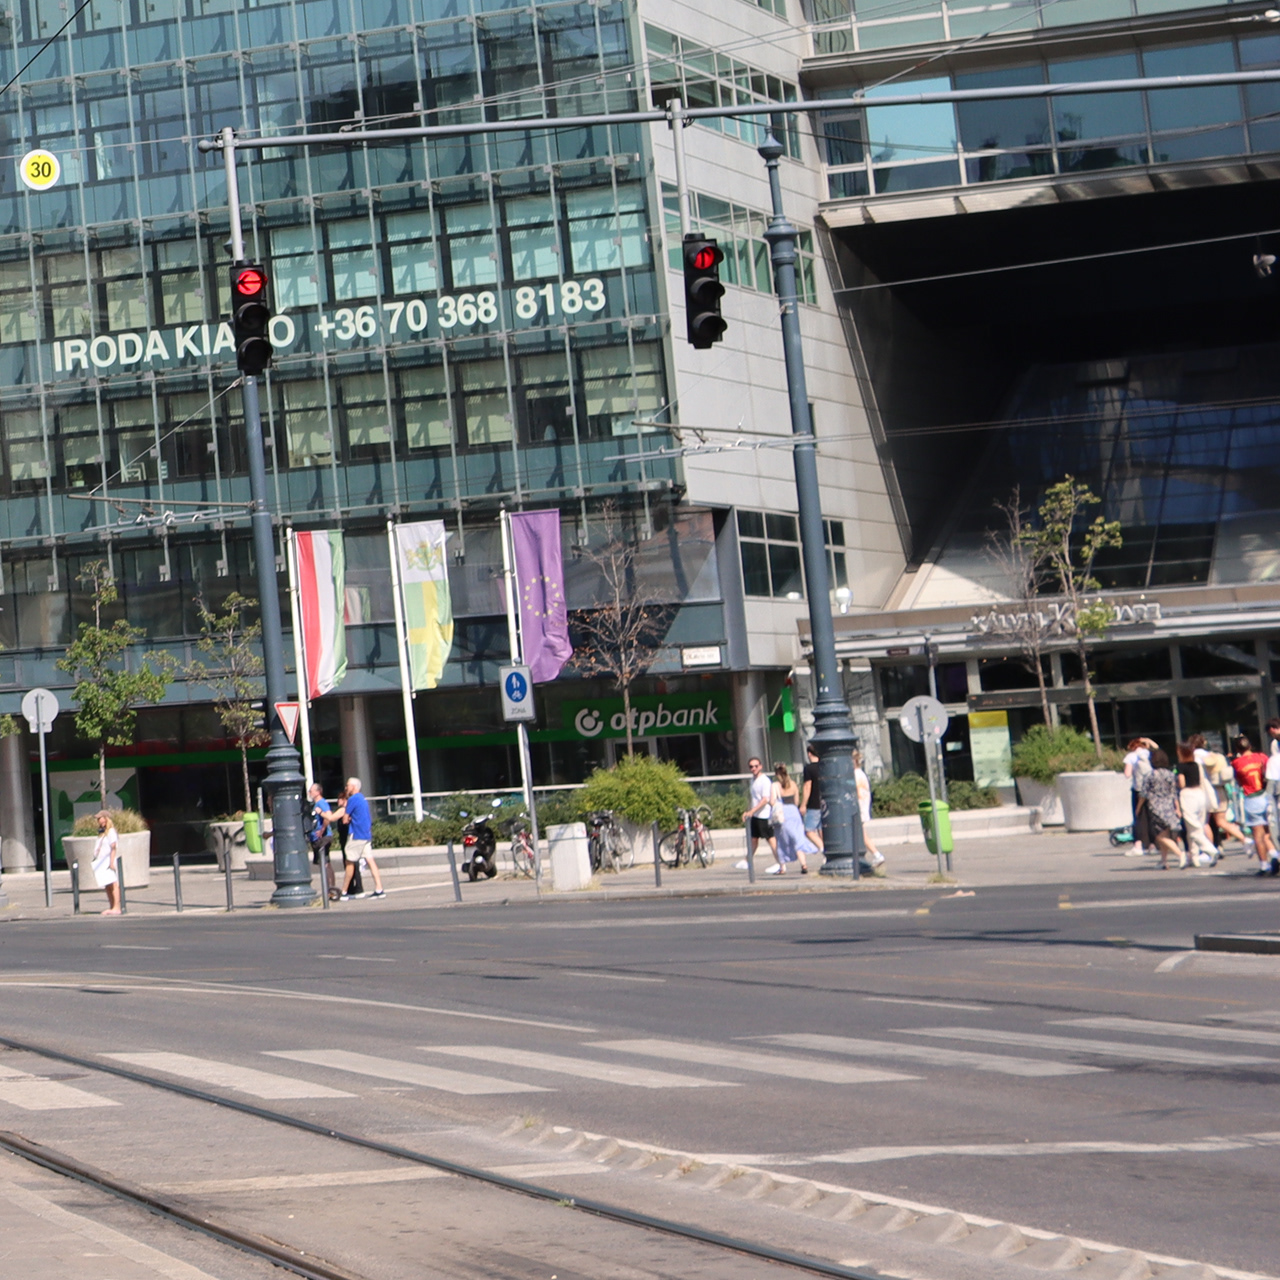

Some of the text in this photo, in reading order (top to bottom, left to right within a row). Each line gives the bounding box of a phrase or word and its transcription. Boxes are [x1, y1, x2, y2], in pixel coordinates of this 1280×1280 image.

[31, 161, 52, 178] 30
[53, 278, 606, 372] IRODA KIAÓ +36 70 368 8183
[610, 700, 718, 736] otpbank
